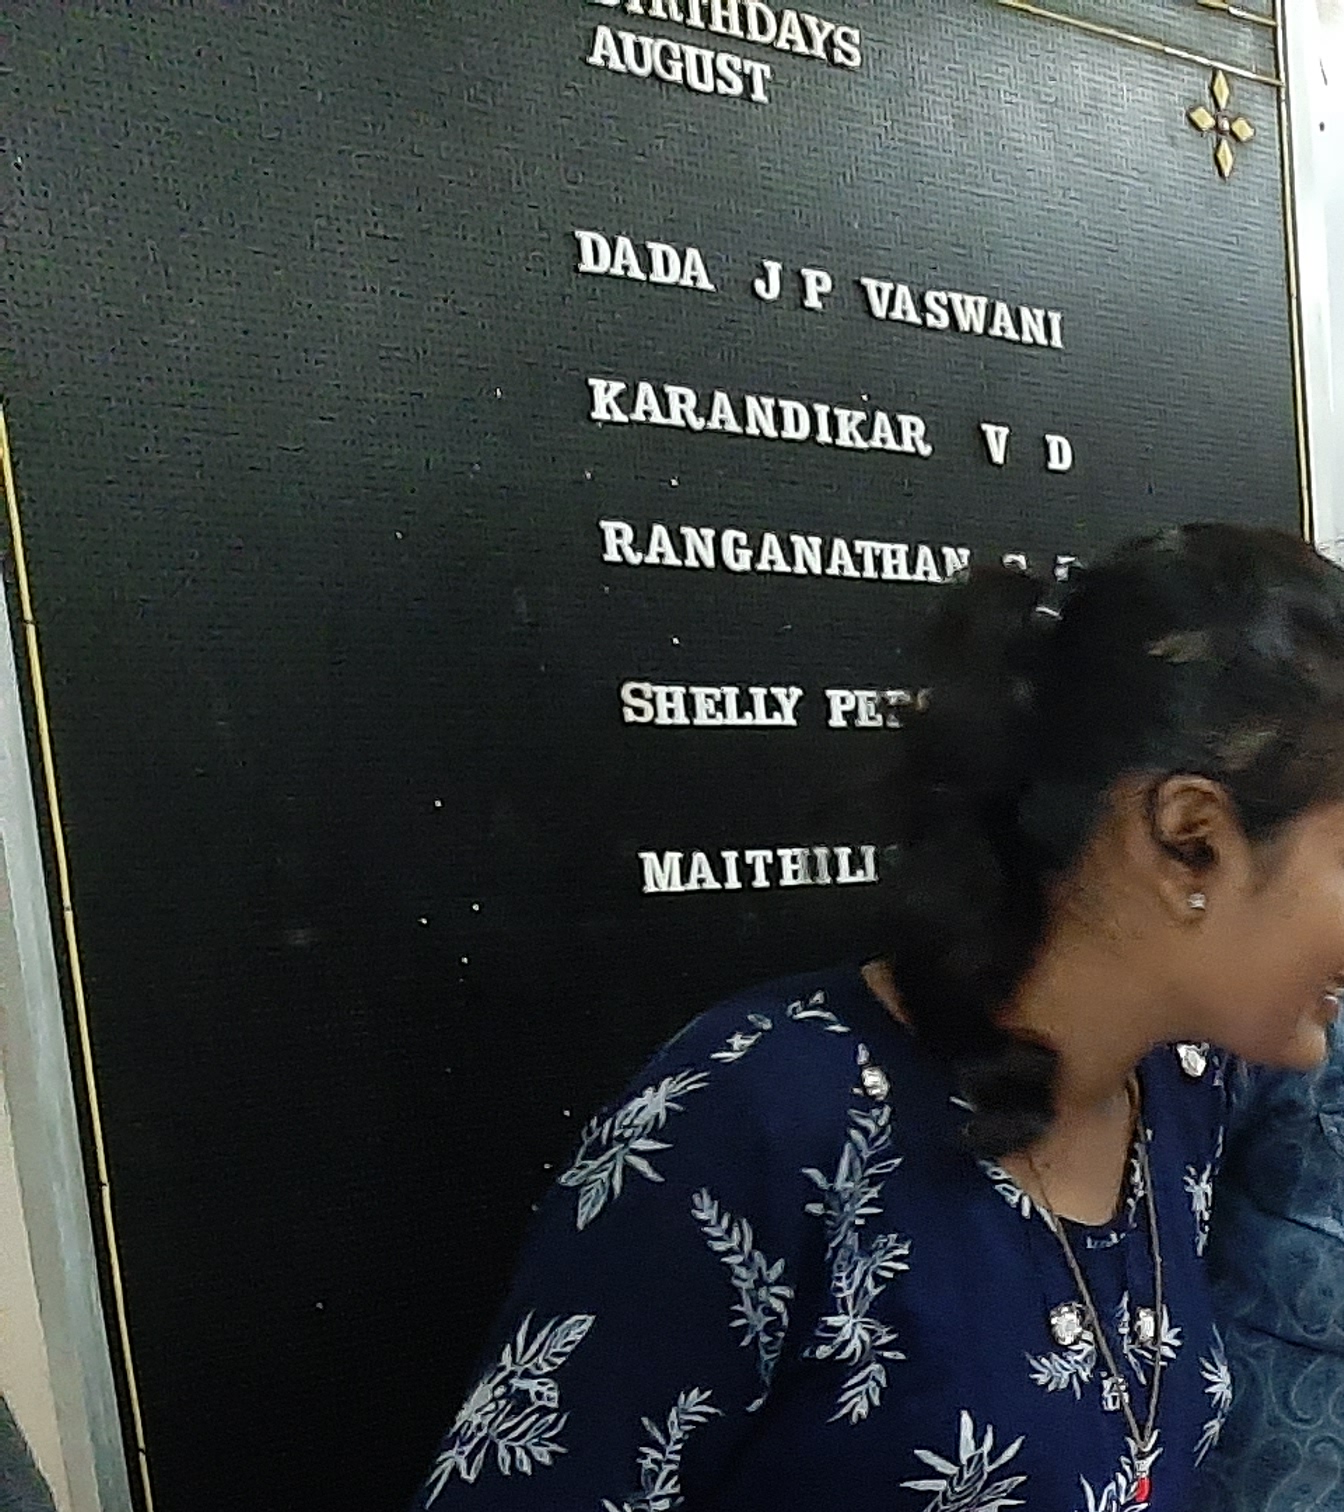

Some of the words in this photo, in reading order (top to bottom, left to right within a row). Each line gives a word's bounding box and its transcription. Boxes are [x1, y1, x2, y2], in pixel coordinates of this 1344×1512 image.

[587, 25, 771, 103] AUGUST
[575, 230, 716, 292] DADA
[754, 260, 783, 302] J
[801, 268, 833, 311] P
[860, 277, 1065, 350] VASWANI
[587, 376, 932, 457] KARANDIKAR
[980, 422, 1009, 465] V
[1045, 434, 1074, 472] D
[601, 521, 970, 584] RANGANATHAN
[621, 682, 802, 728] SHELLY
[639, 845, 880, 894] MAITHILI
